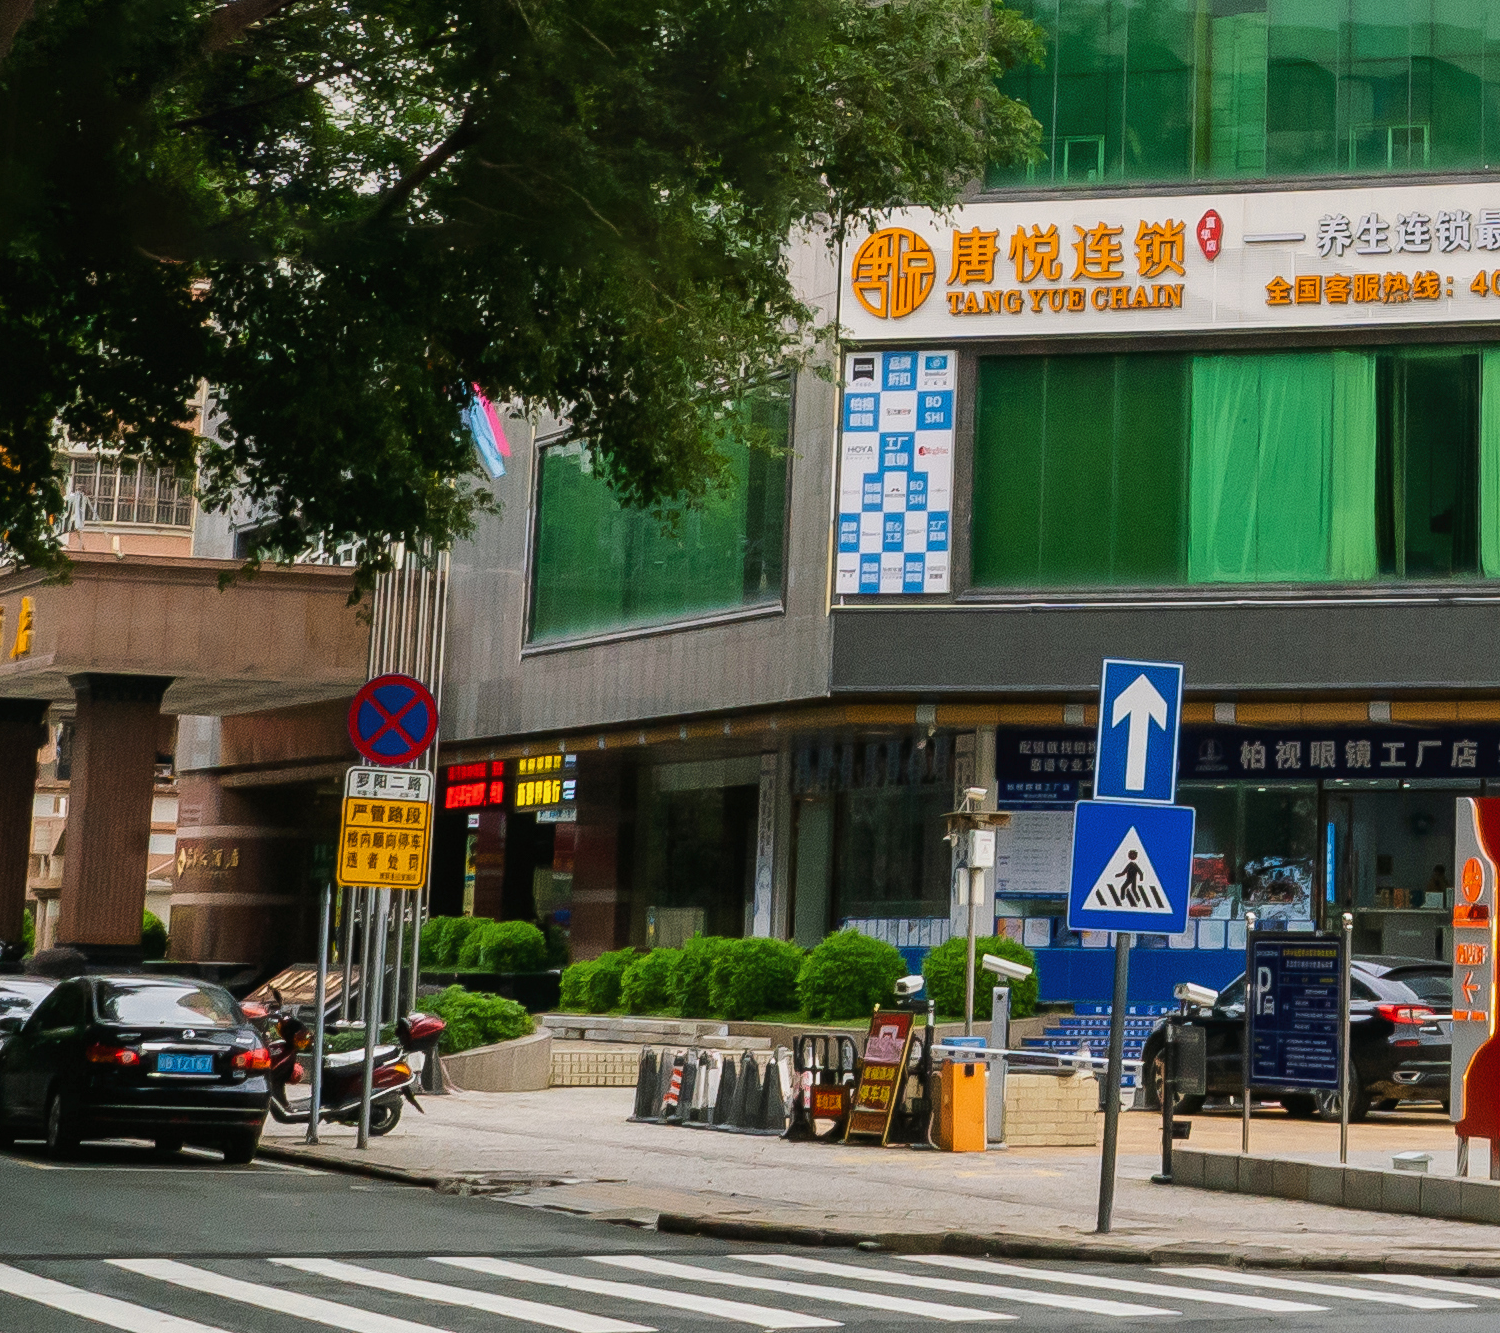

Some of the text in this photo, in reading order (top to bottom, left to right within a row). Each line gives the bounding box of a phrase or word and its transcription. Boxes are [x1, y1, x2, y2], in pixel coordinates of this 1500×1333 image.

[946, 218, 1187, 286] 唐悦连锁
[947, 284, 1186, 315] TANG YUE CHAIN
[925, 395, 942, 408] BO
[924, 411, 945, 424] SHI
[1240, 738, 1478, 770] 柏视眼镜工厂店
[356, 773, 422, 791] 罗阳二路
[352, 804, 422, 824] 严管路段
